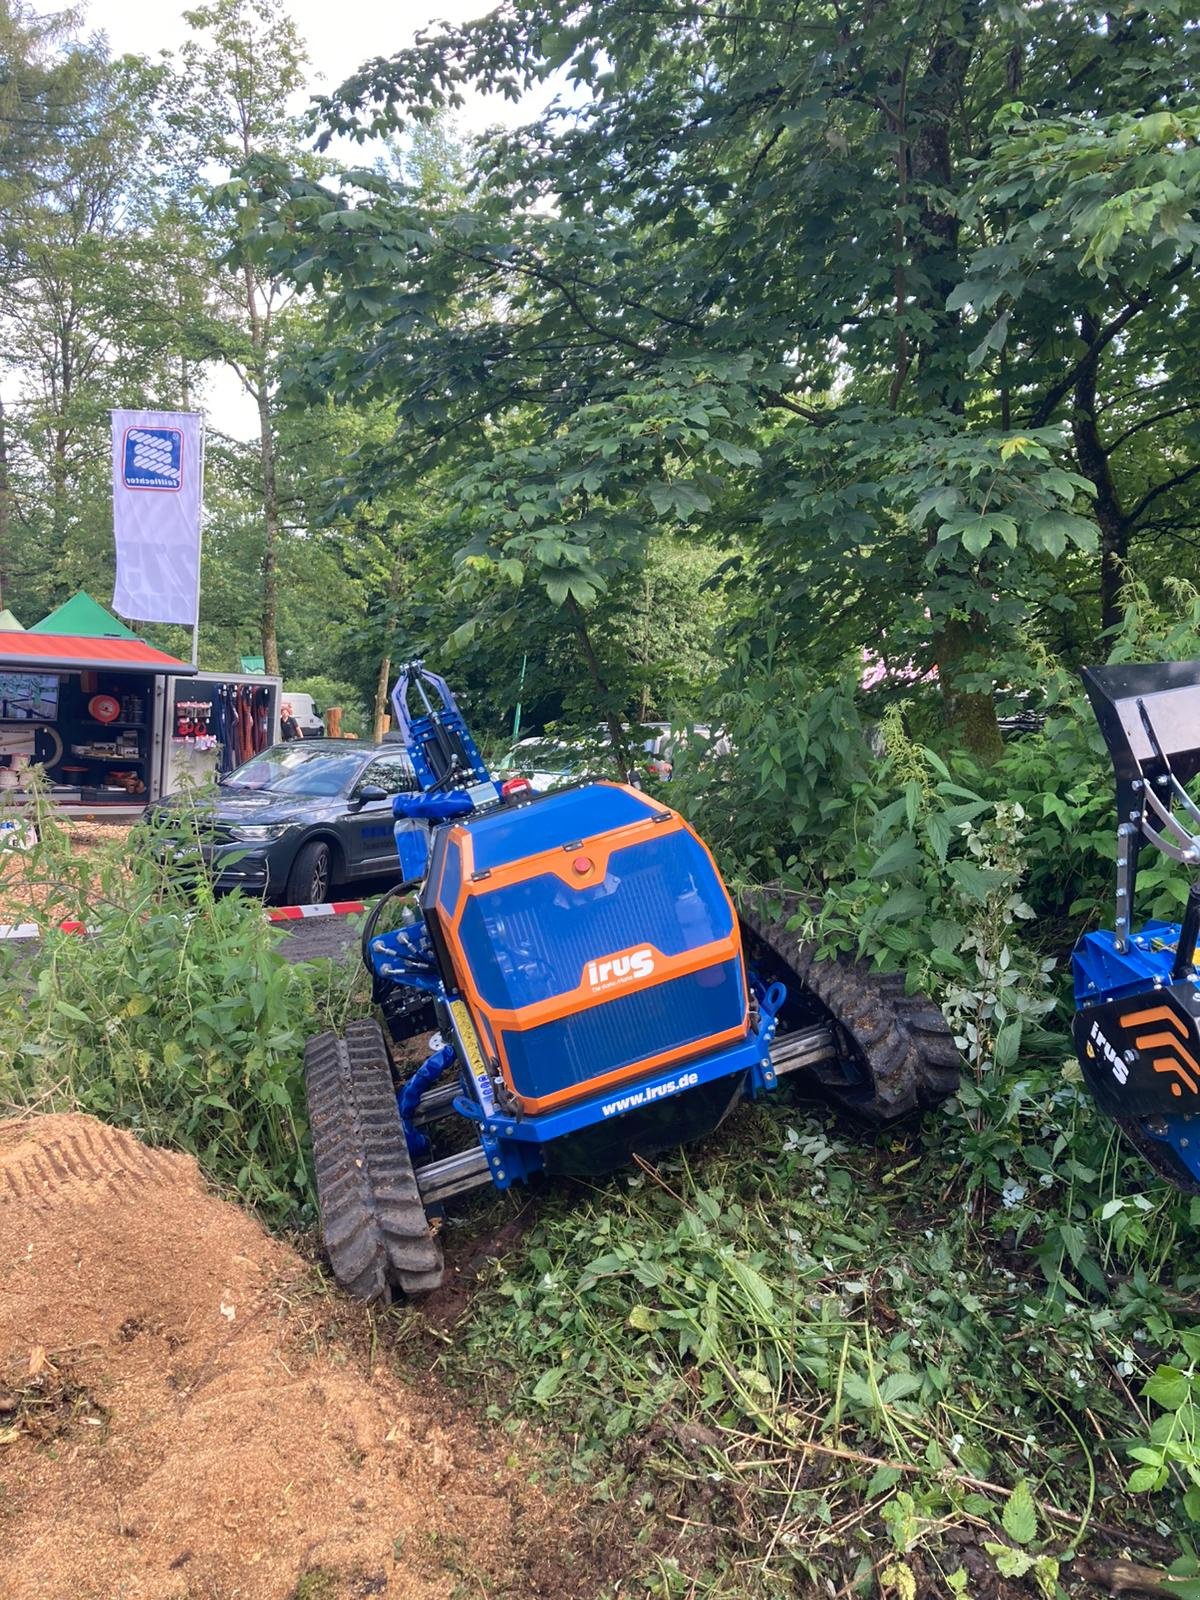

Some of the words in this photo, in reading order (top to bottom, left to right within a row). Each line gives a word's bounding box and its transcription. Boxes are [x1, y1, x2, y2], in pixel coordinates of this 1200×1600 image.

[588, 949, 655, 986] irus
[1090, 1020, 1129, 1085] irus
[601, 1072, 699, 1116] www.irus.de
